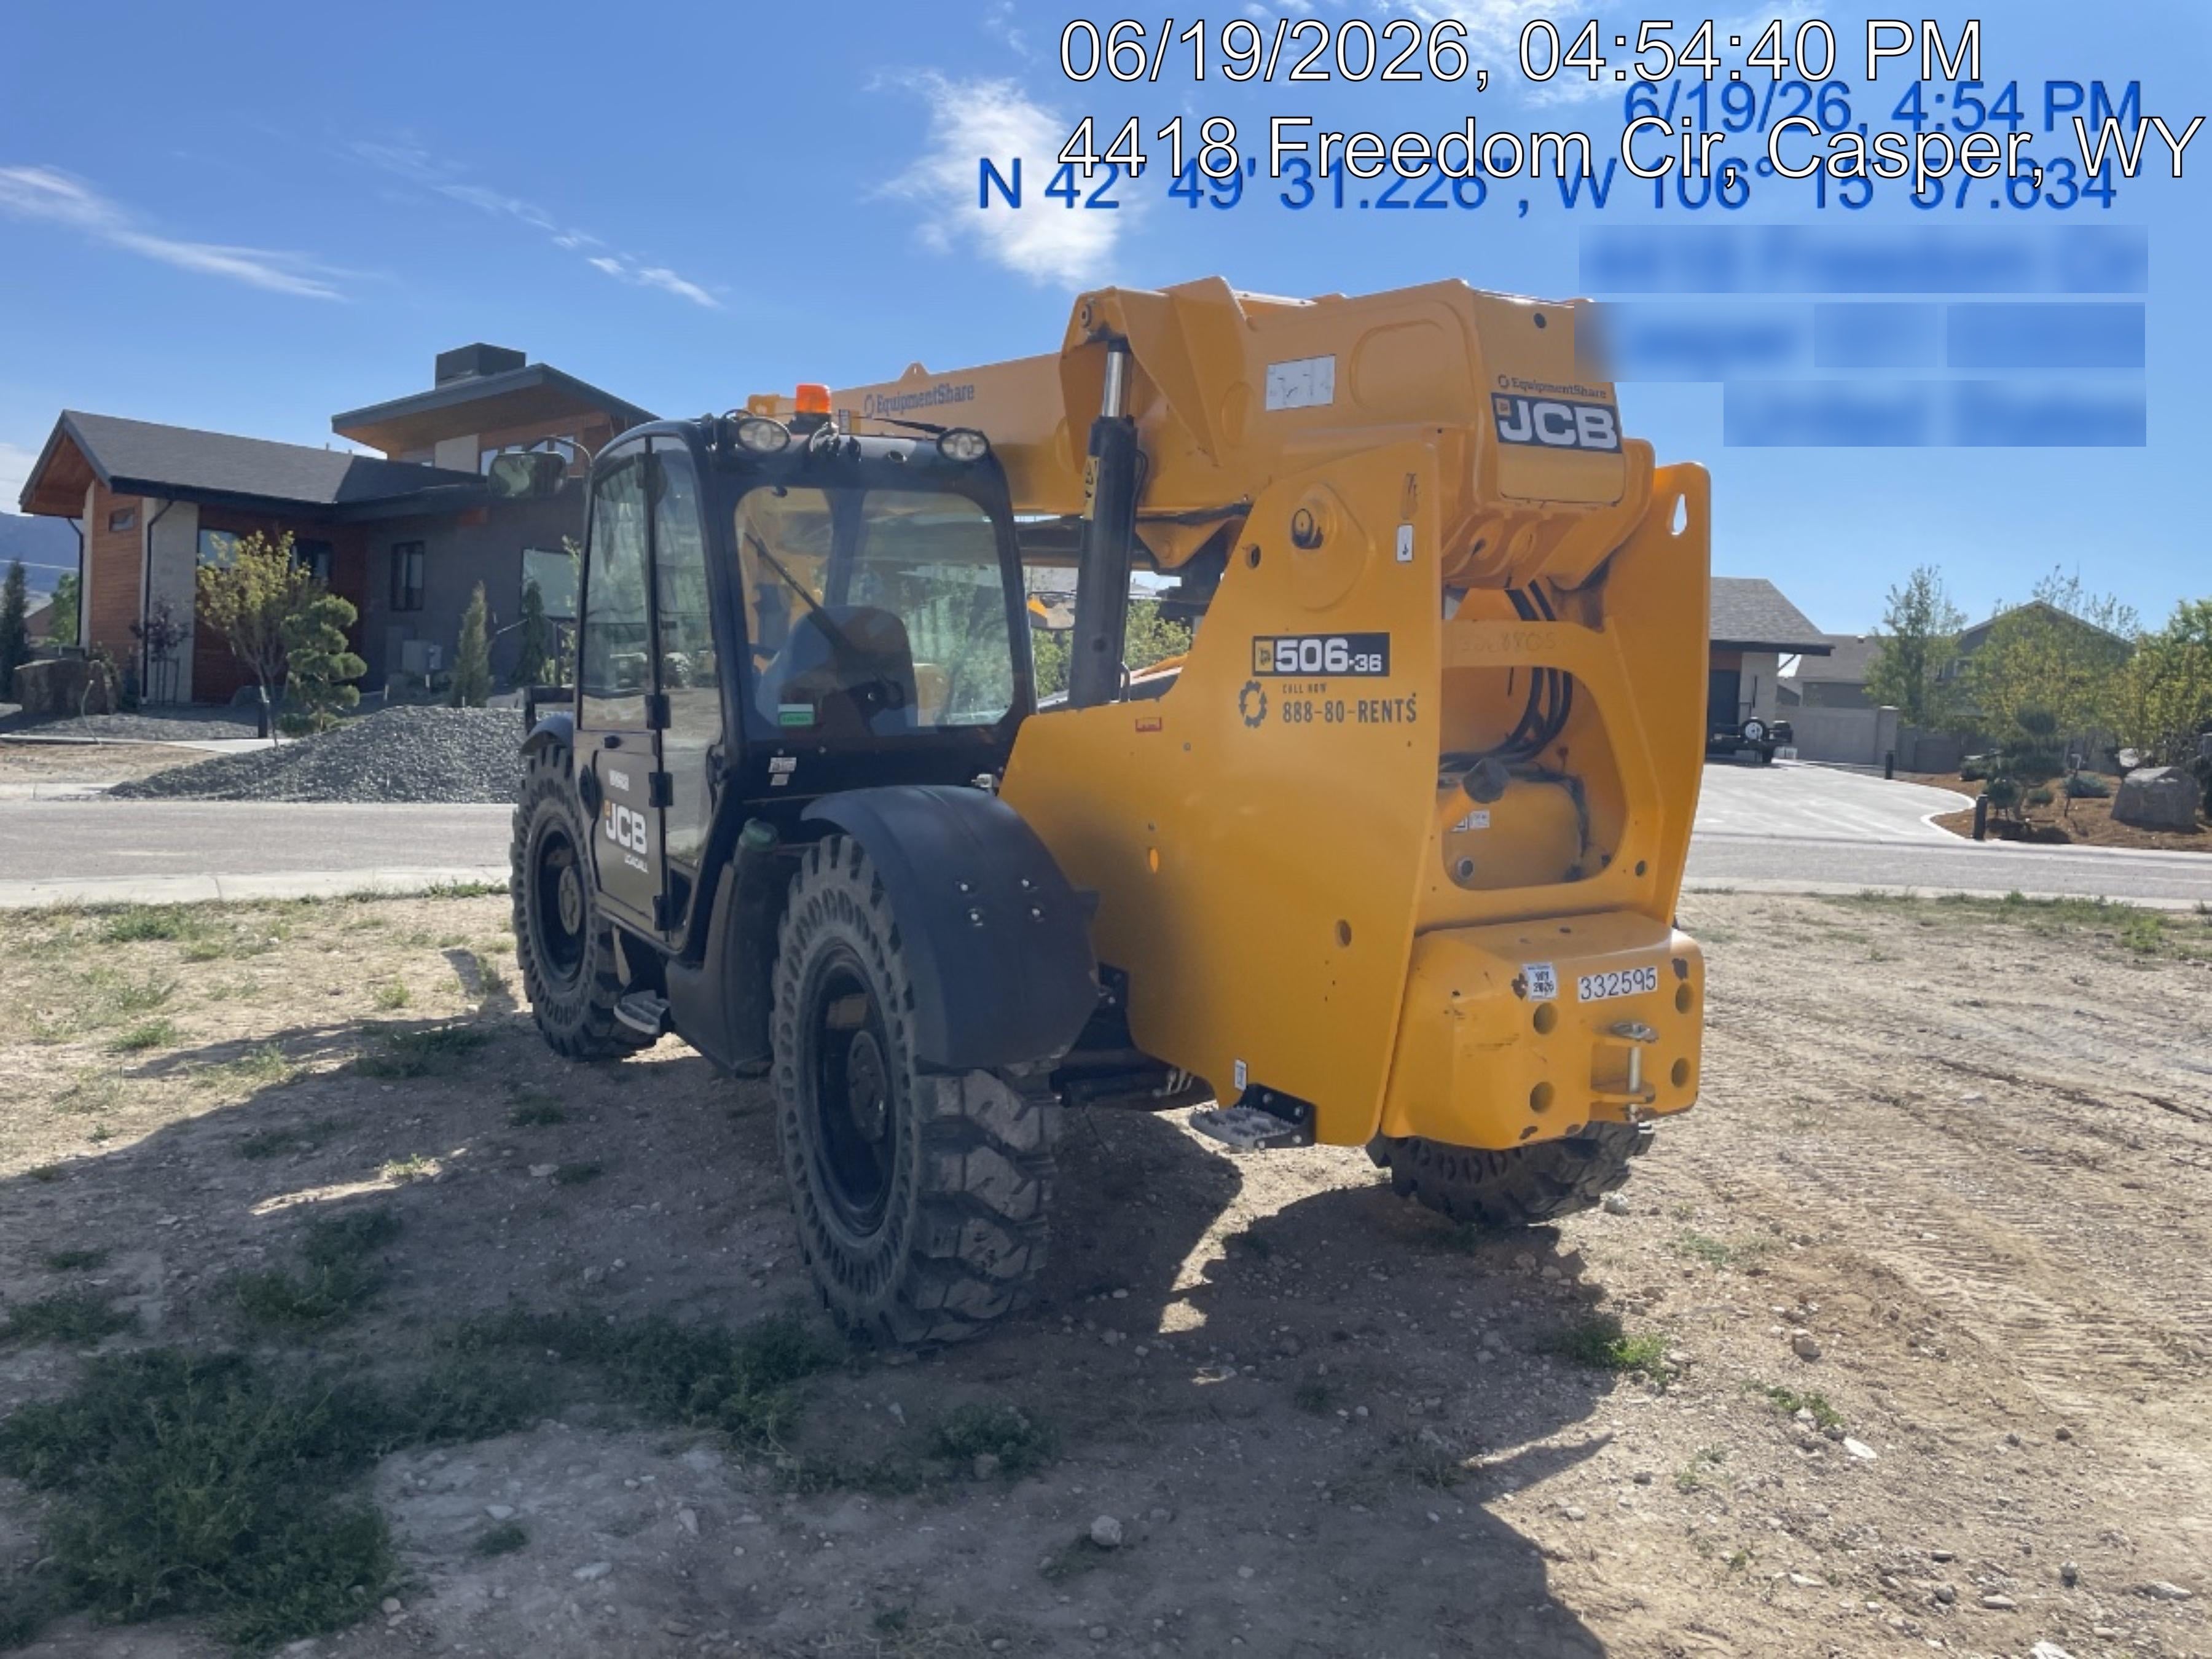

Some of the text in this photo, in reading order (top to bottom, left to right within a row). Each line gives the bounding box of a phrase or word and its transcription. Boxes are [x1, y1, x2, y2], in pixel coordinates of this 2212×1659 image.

[877, 383, 975, 417] EquipmentShare
[1511, 377, 1607, 399] EquipmentShare
[1499, 399, 1618, 449] JCB
[1282, 697, 1417, 723] 888-80-RENTS
[606, 802, 648, 855] JCB
[1580, 967, 1657, 1000] 332595
